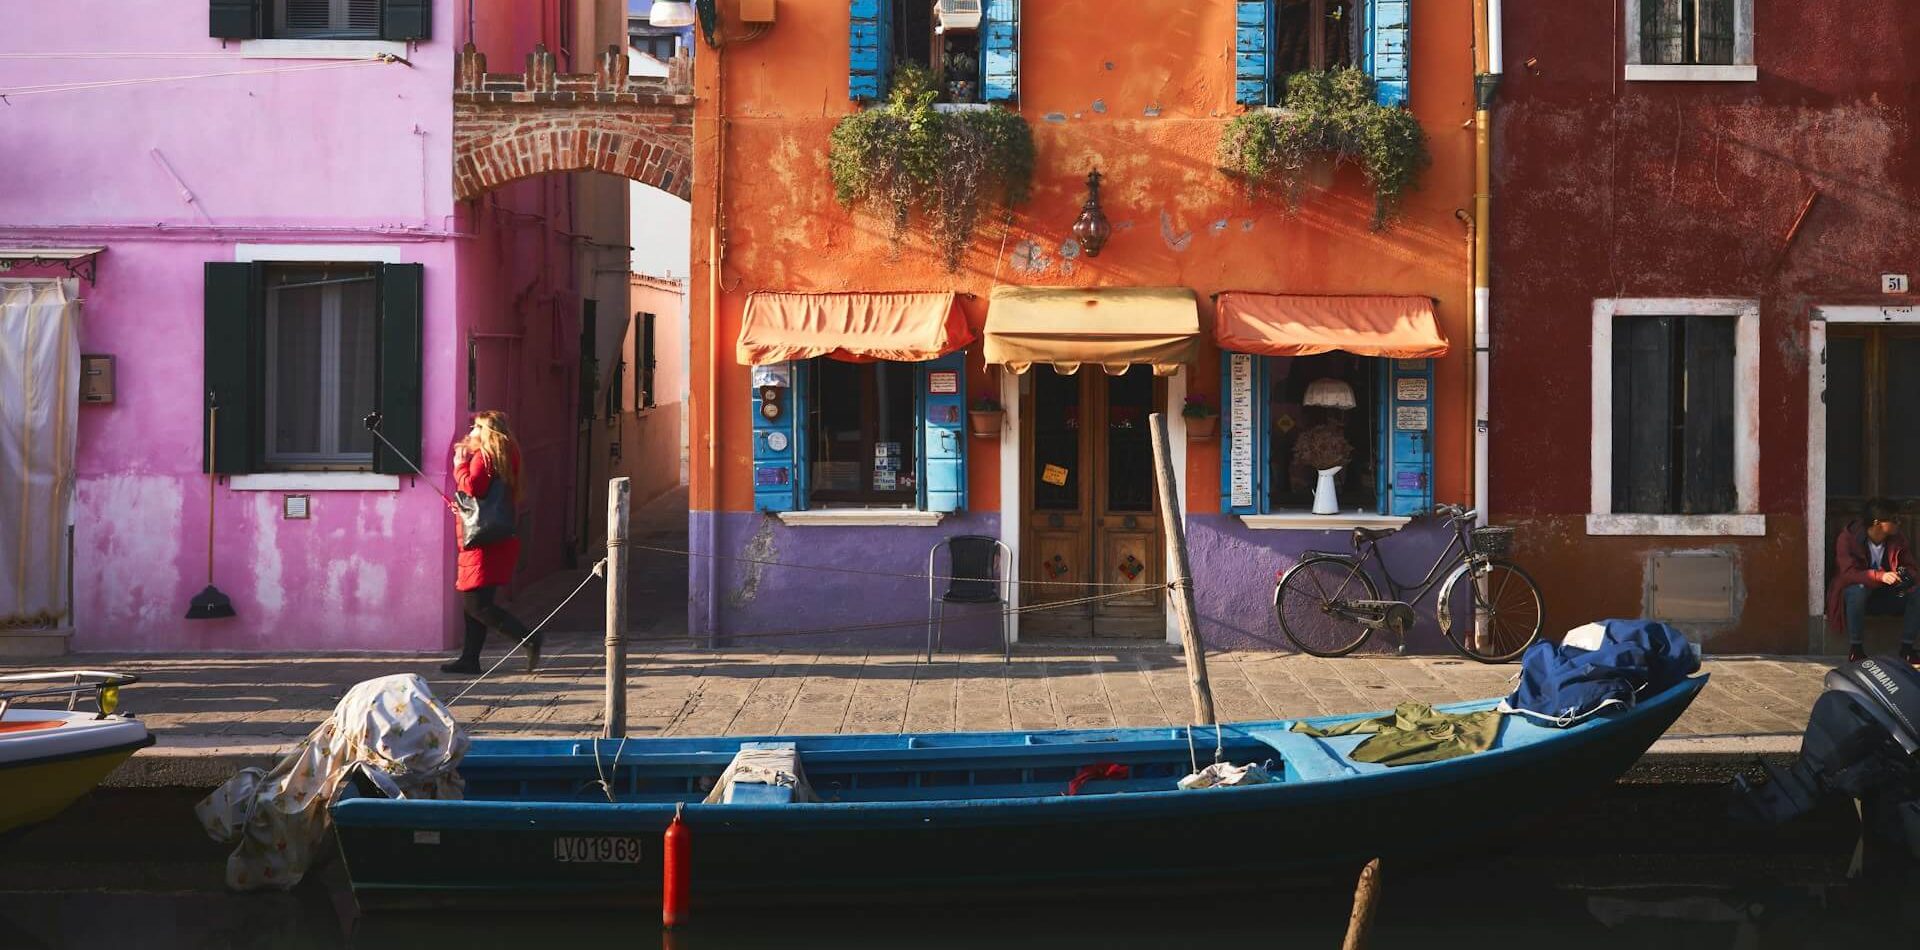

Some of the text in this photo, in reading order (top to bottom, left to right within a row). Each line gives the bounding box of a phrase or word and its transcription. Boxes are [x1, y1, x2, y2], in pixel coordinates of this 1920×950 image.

[1888, 277, 1901, 291] 51
[1868, 664, 1899, 694] YAMAHA
[556, 837, 639, 861] LV01969
